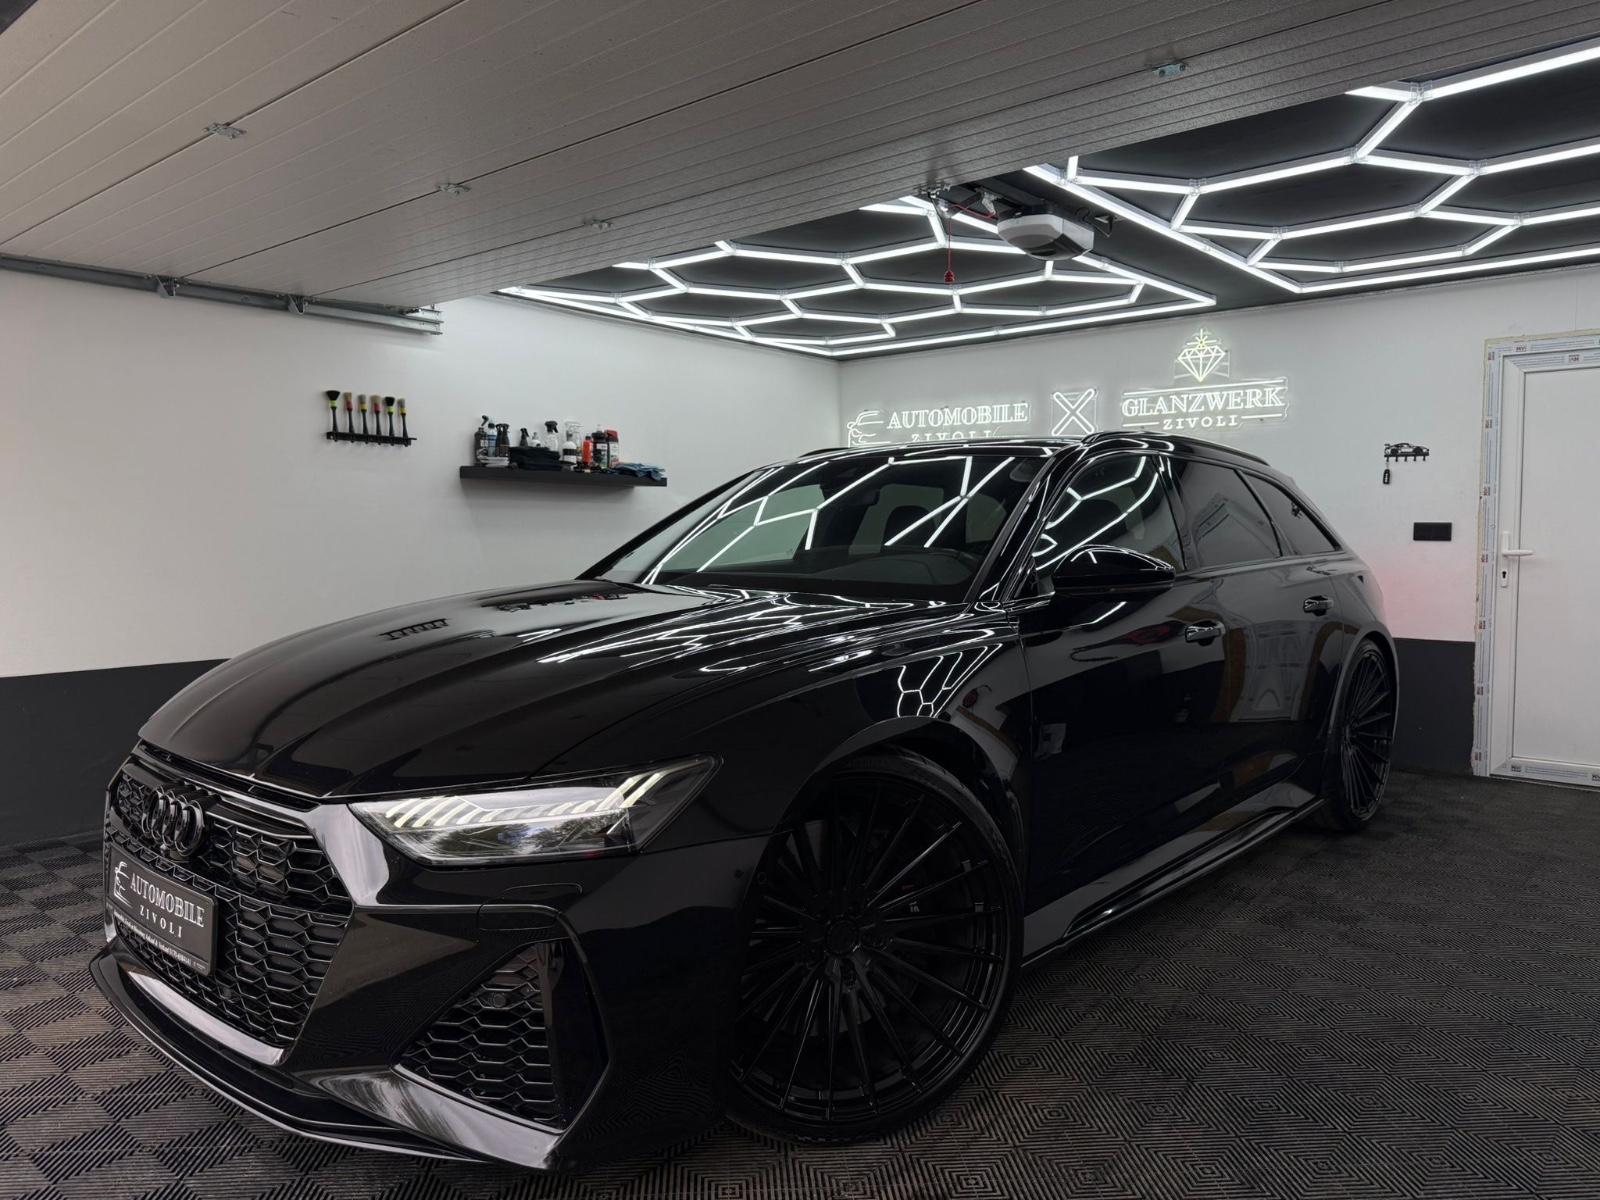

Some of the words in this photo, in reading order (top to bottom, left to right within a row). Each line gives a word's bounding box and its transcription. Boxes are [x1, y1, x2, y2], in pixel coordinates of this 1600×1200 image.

[886, 402, 1029, 429] AUTOMOBILE
[1121, 386, 1286, 417] GLANZWERK
[1163, 415, 1239, 430] ZIVOLI
[130, 873, 205, 928] AUTOMOBILE
[139, 904, 183, 938] ZIVOLI
